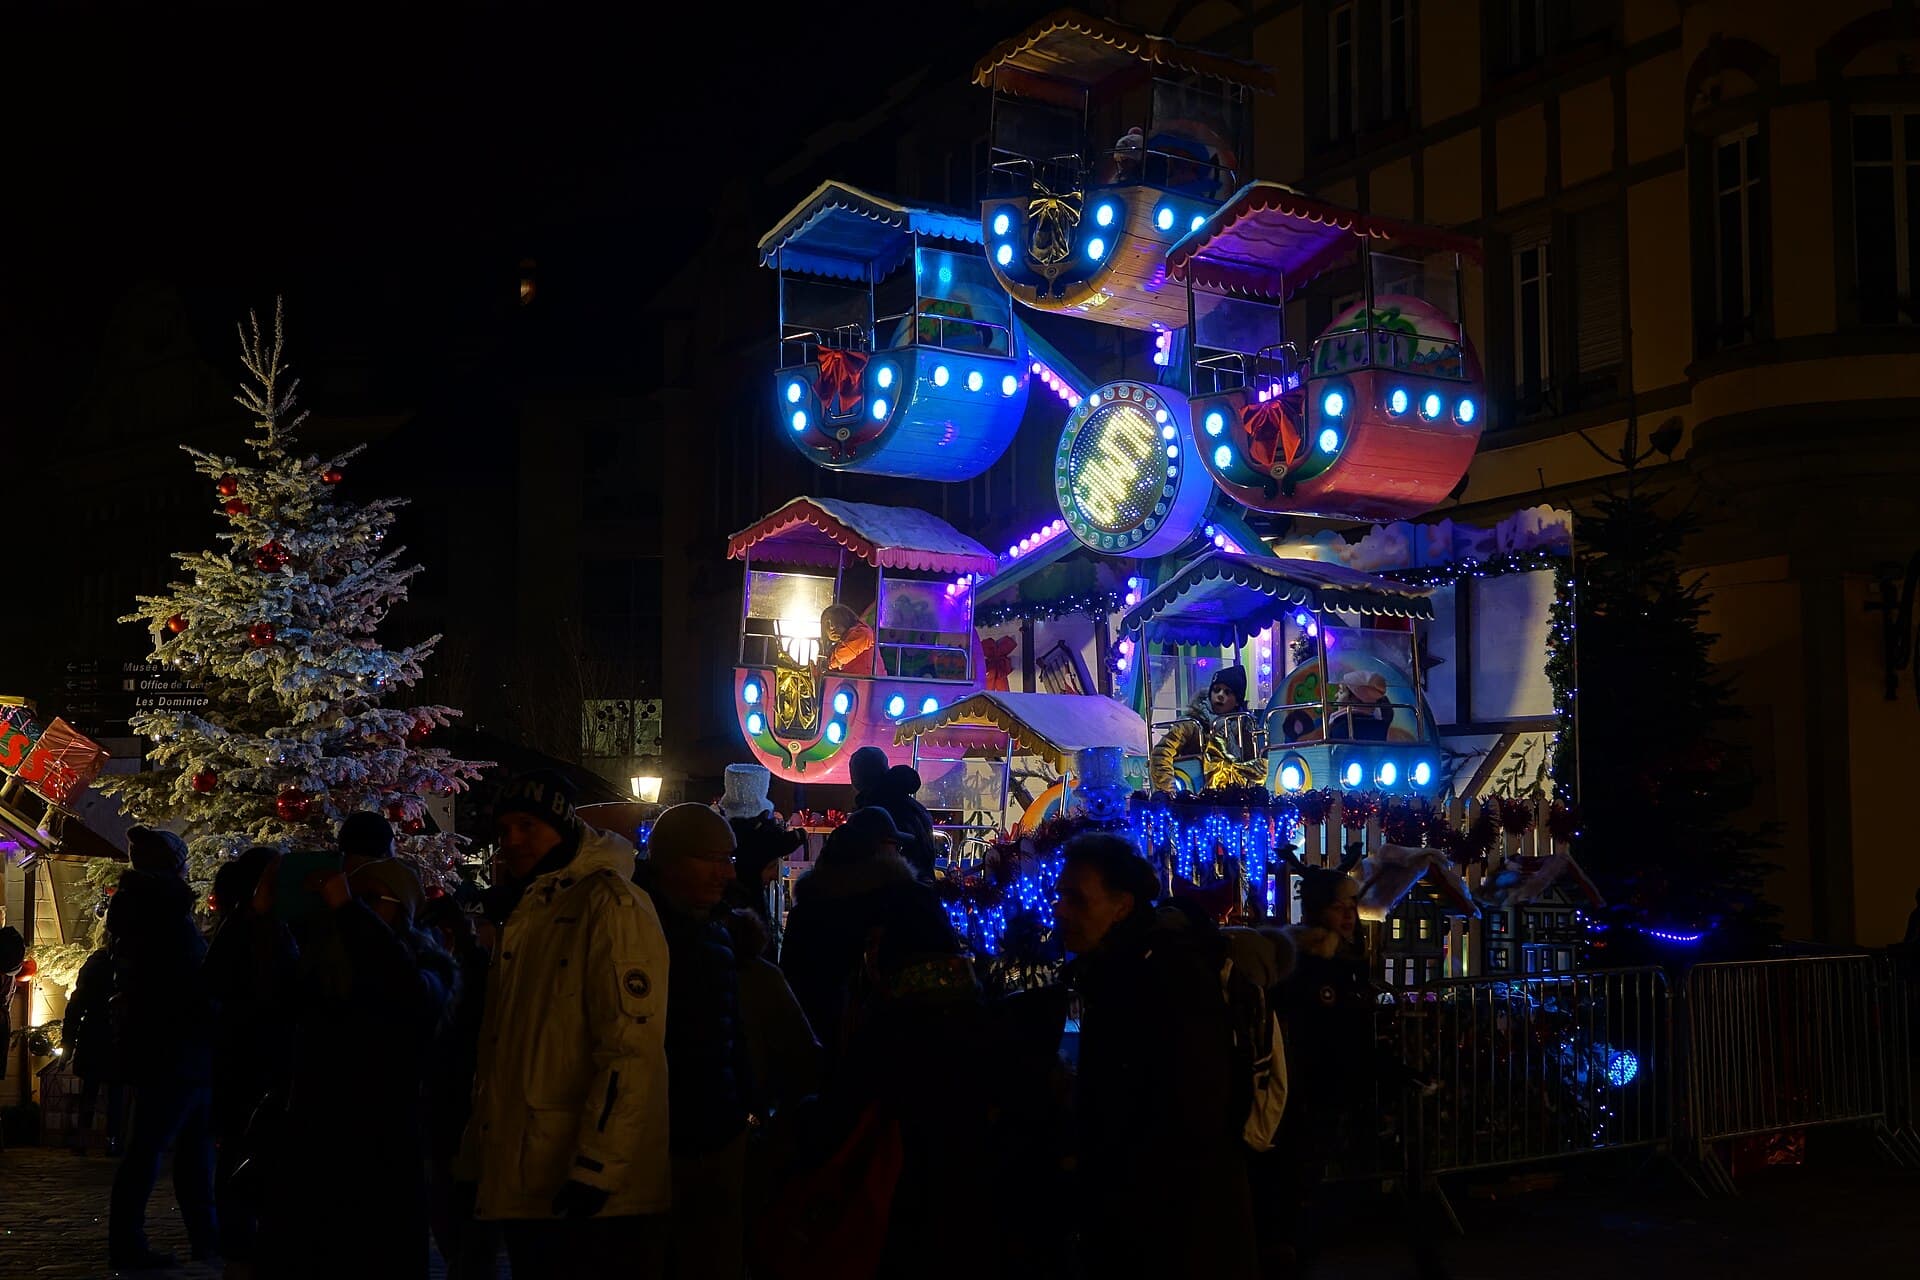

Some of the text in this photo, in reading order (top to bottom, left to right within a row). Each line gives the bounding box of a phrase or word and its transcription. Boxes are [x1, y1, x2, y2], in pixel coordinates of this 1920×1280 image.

[140, 680, 169, 690] Office
[135, 696, 209, 706] Les Dominica
